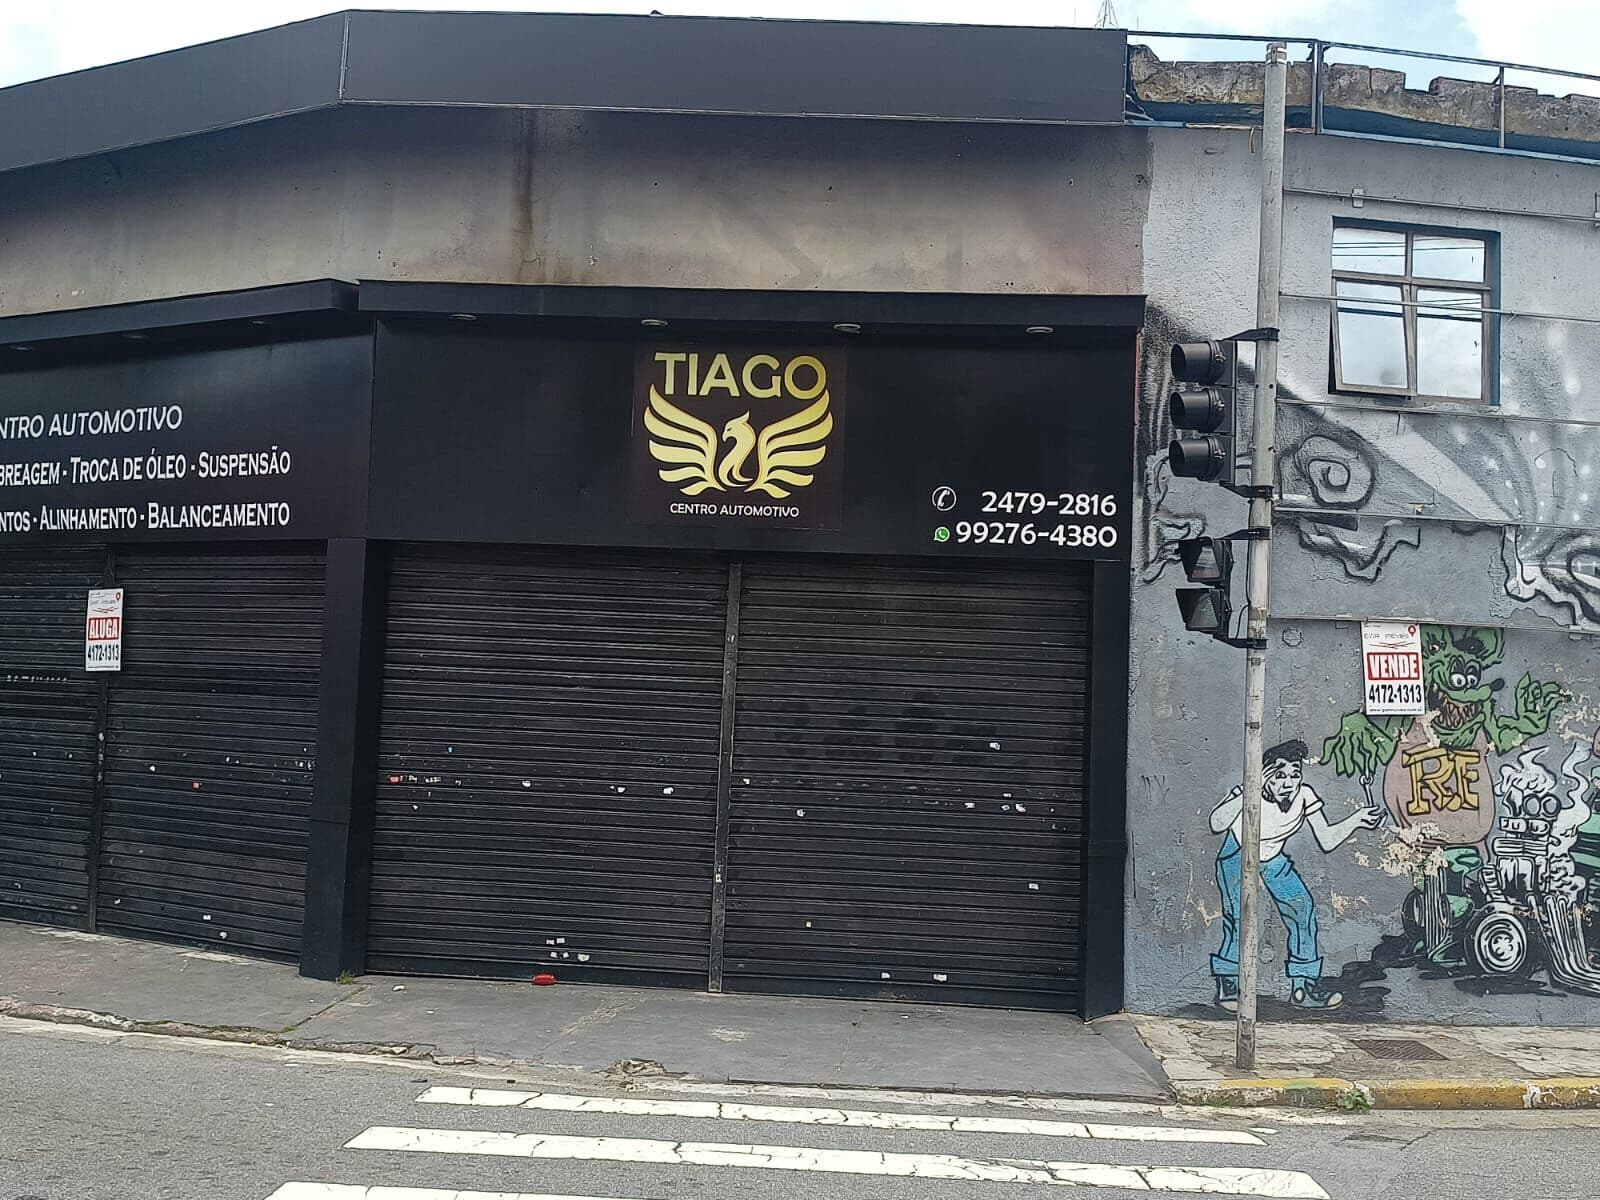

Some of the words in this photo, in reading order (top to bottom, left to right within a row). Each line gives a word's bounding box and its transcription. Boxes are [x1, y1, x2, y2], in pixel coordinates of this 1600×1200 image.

[654, 352, 827, 400] TIAGO
[49, 405, 183, 436] AUTOMOTIVO
[70, 456, 119, 483] TROCA
[123, 457, 143, 480] DE
[146, 448, 186, 480] ÓLEO
[198, 446, 291, 478] SUSPENSÃO
[40, 505, 137, 530] ALINHAMENTO
[148, 502, 290, 529] BALANCEAMENTO
[670, 503, 717, 515] CENTRO
[720, 505, 800, 518] AUTOMOTIVO
[981, 491, 1117, 516] 2479-2816
[955, 521, 1118, 547] 99276-4380
[89, 617, 119, 639] ALUGA
[1368, 653, 1419, 679] VENDE
